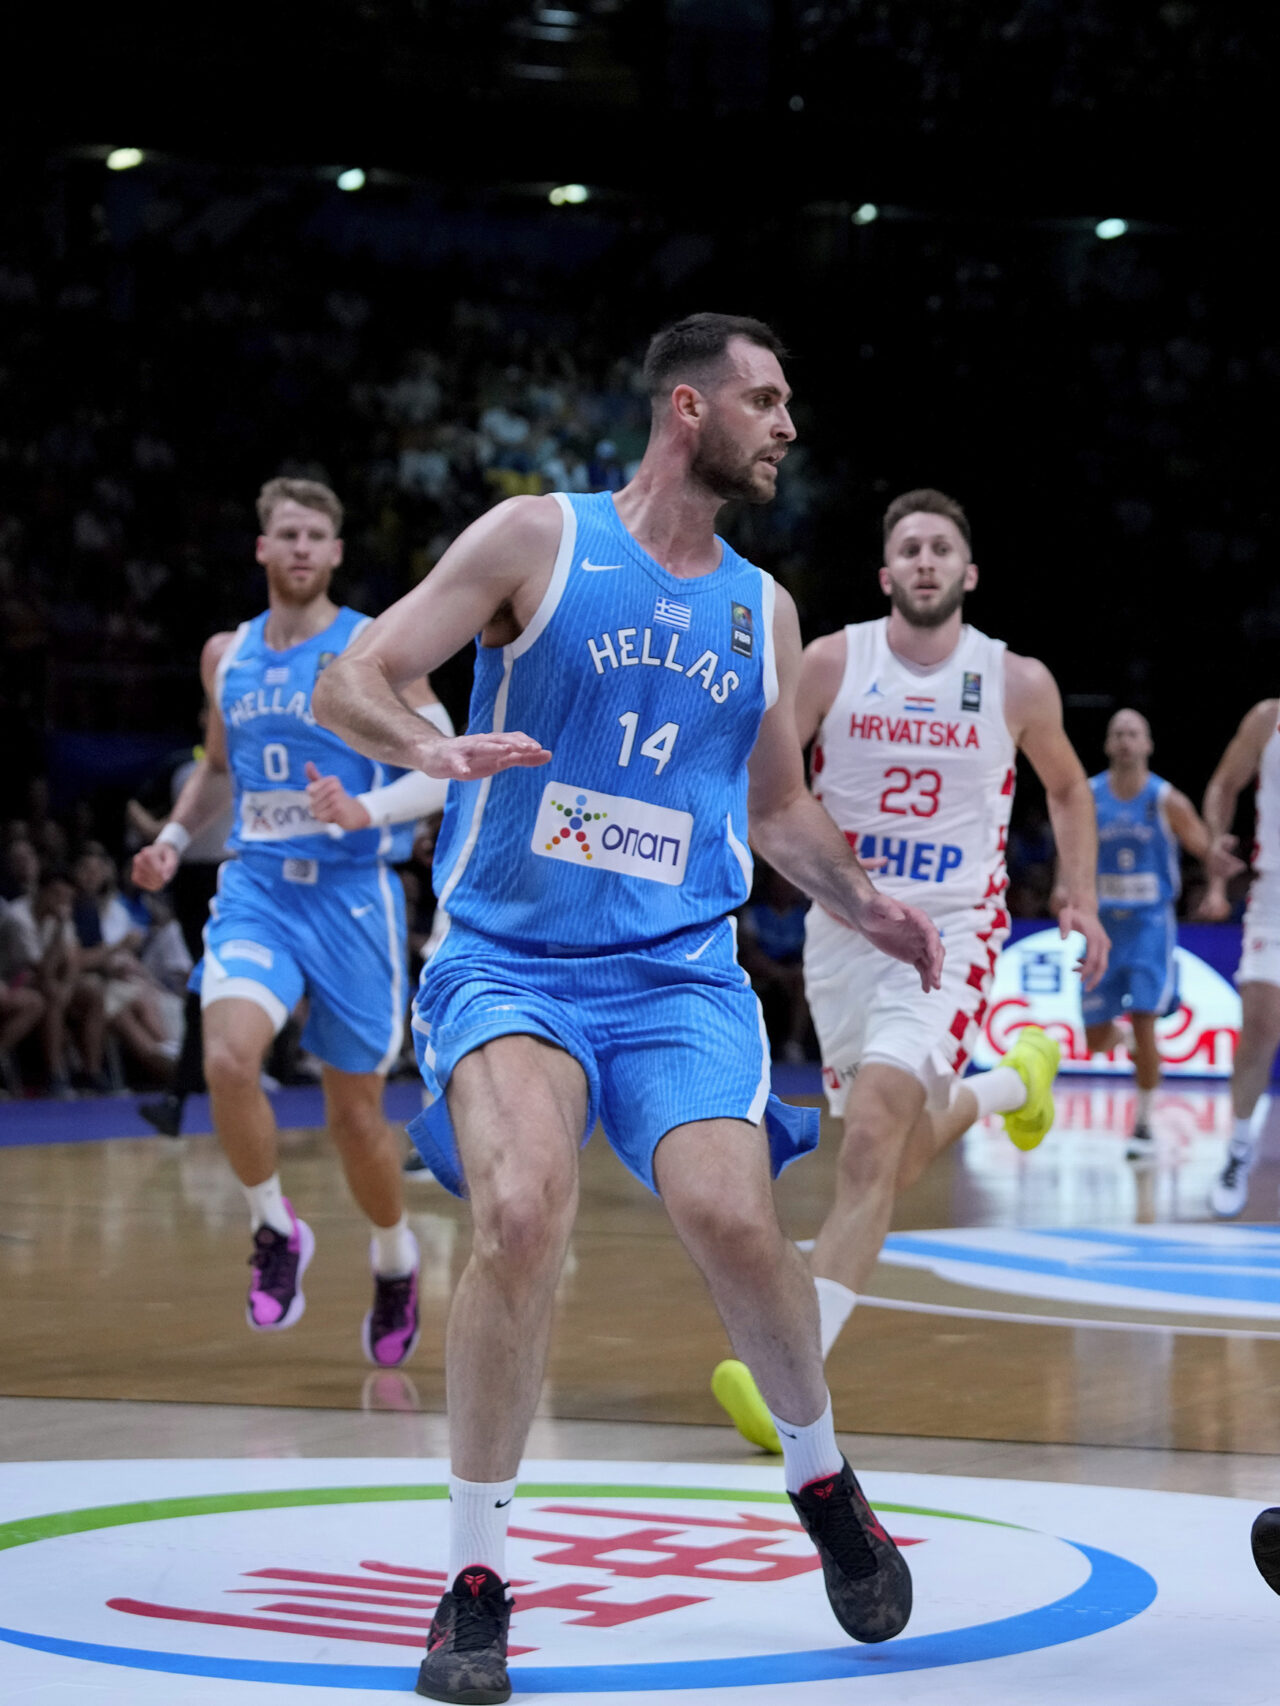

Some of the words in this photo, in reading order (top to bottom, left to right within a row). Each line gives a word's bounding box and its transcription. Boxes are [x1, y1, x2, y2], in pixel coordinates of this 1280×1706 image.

[587, 627, 740, 704] HELLAS
[618, 711, 680, 776] 14
[849, 713, 980, 749] HRVATSKA
[263, 743, 289, 782] 0
[880, 766, 942, 818] 23
[879, 836, 963, 882] HEP
